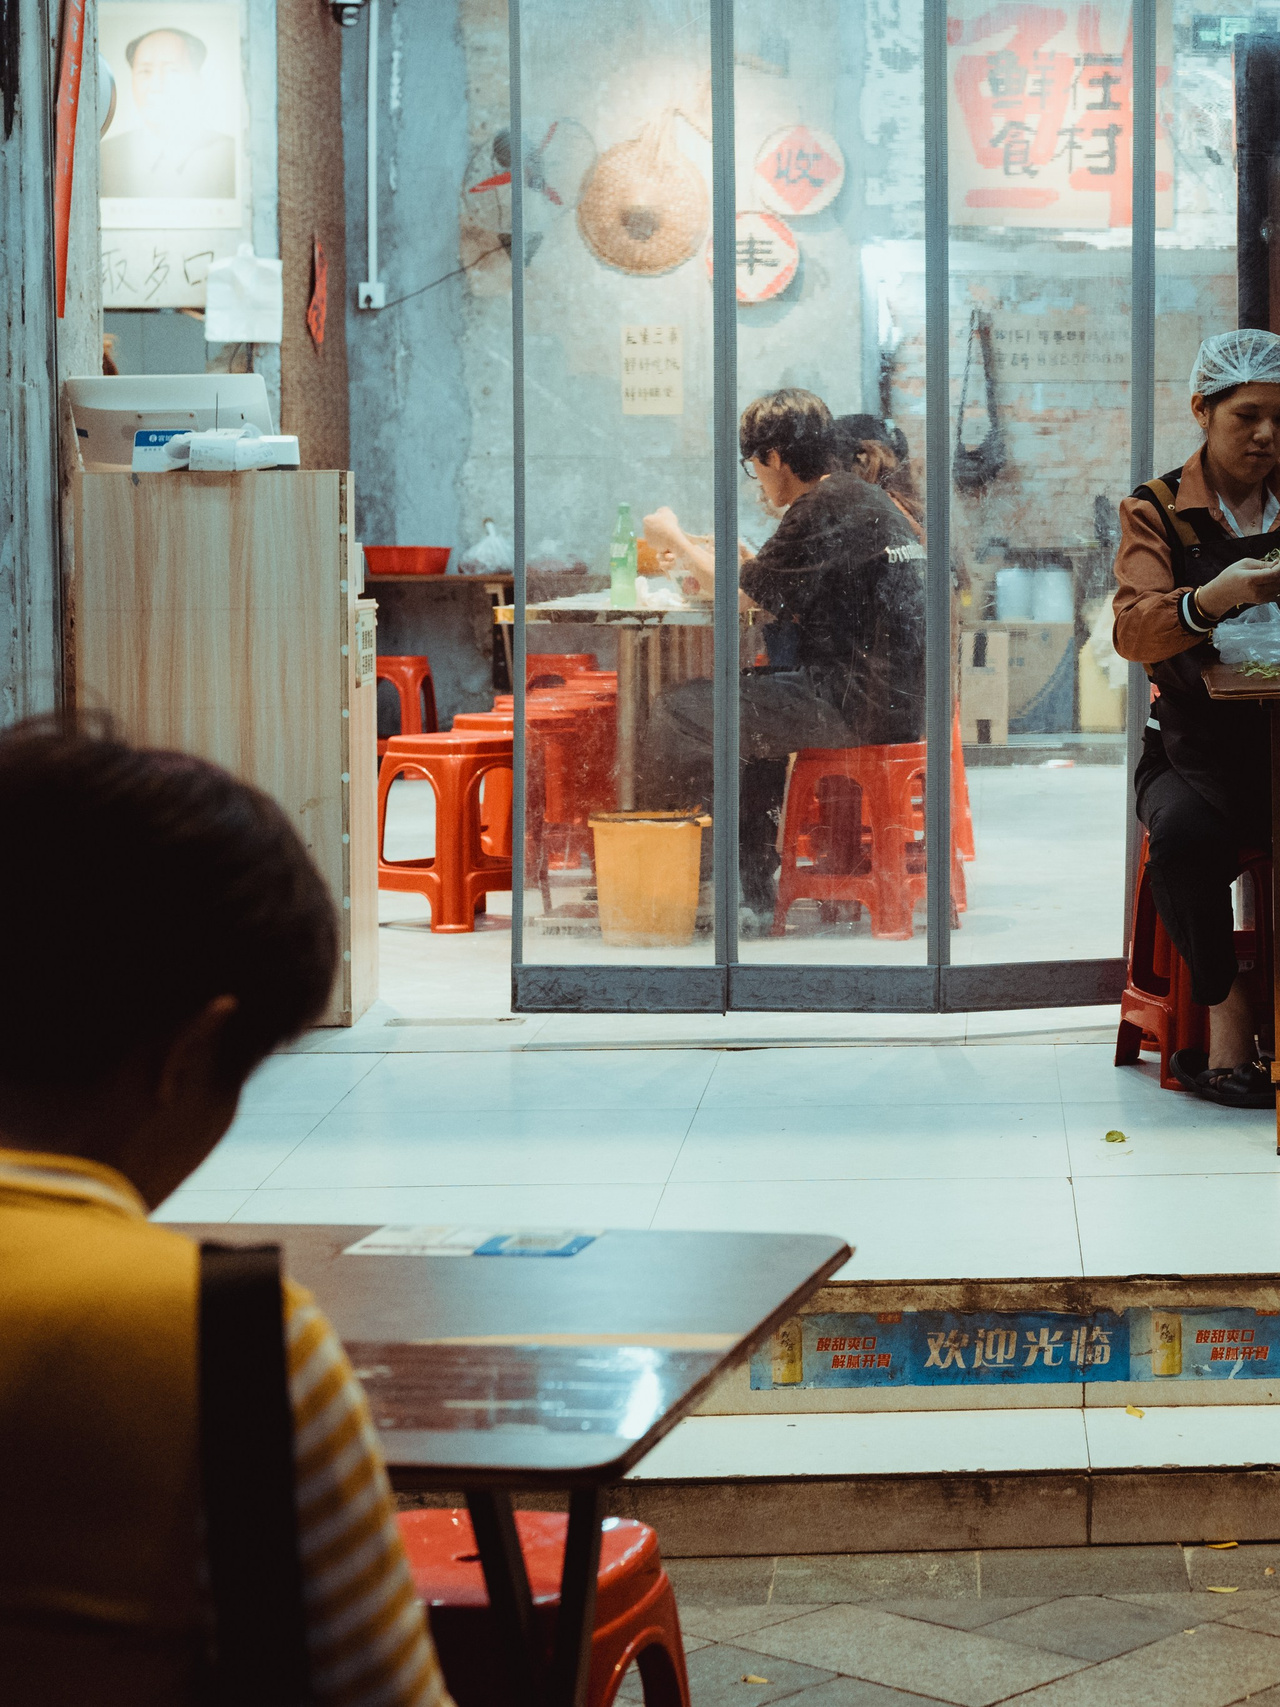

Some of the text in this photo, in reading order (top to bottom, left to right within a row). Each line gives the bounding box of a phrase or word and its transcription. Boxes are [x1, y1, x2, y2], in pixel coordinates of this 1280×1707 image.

[775, 149, 825, 187] 收
[815, 1336, 877, 1352] 酸甜爽口
[1195, 1329, 1255, 1344] 酸甜爽口
[923, 1326, 1113, 1369] 欢迎光临
[1210, 1346, 1270, 1361] 解腻开胃
[831, 1353, 892, 1369] 解腻开胃
